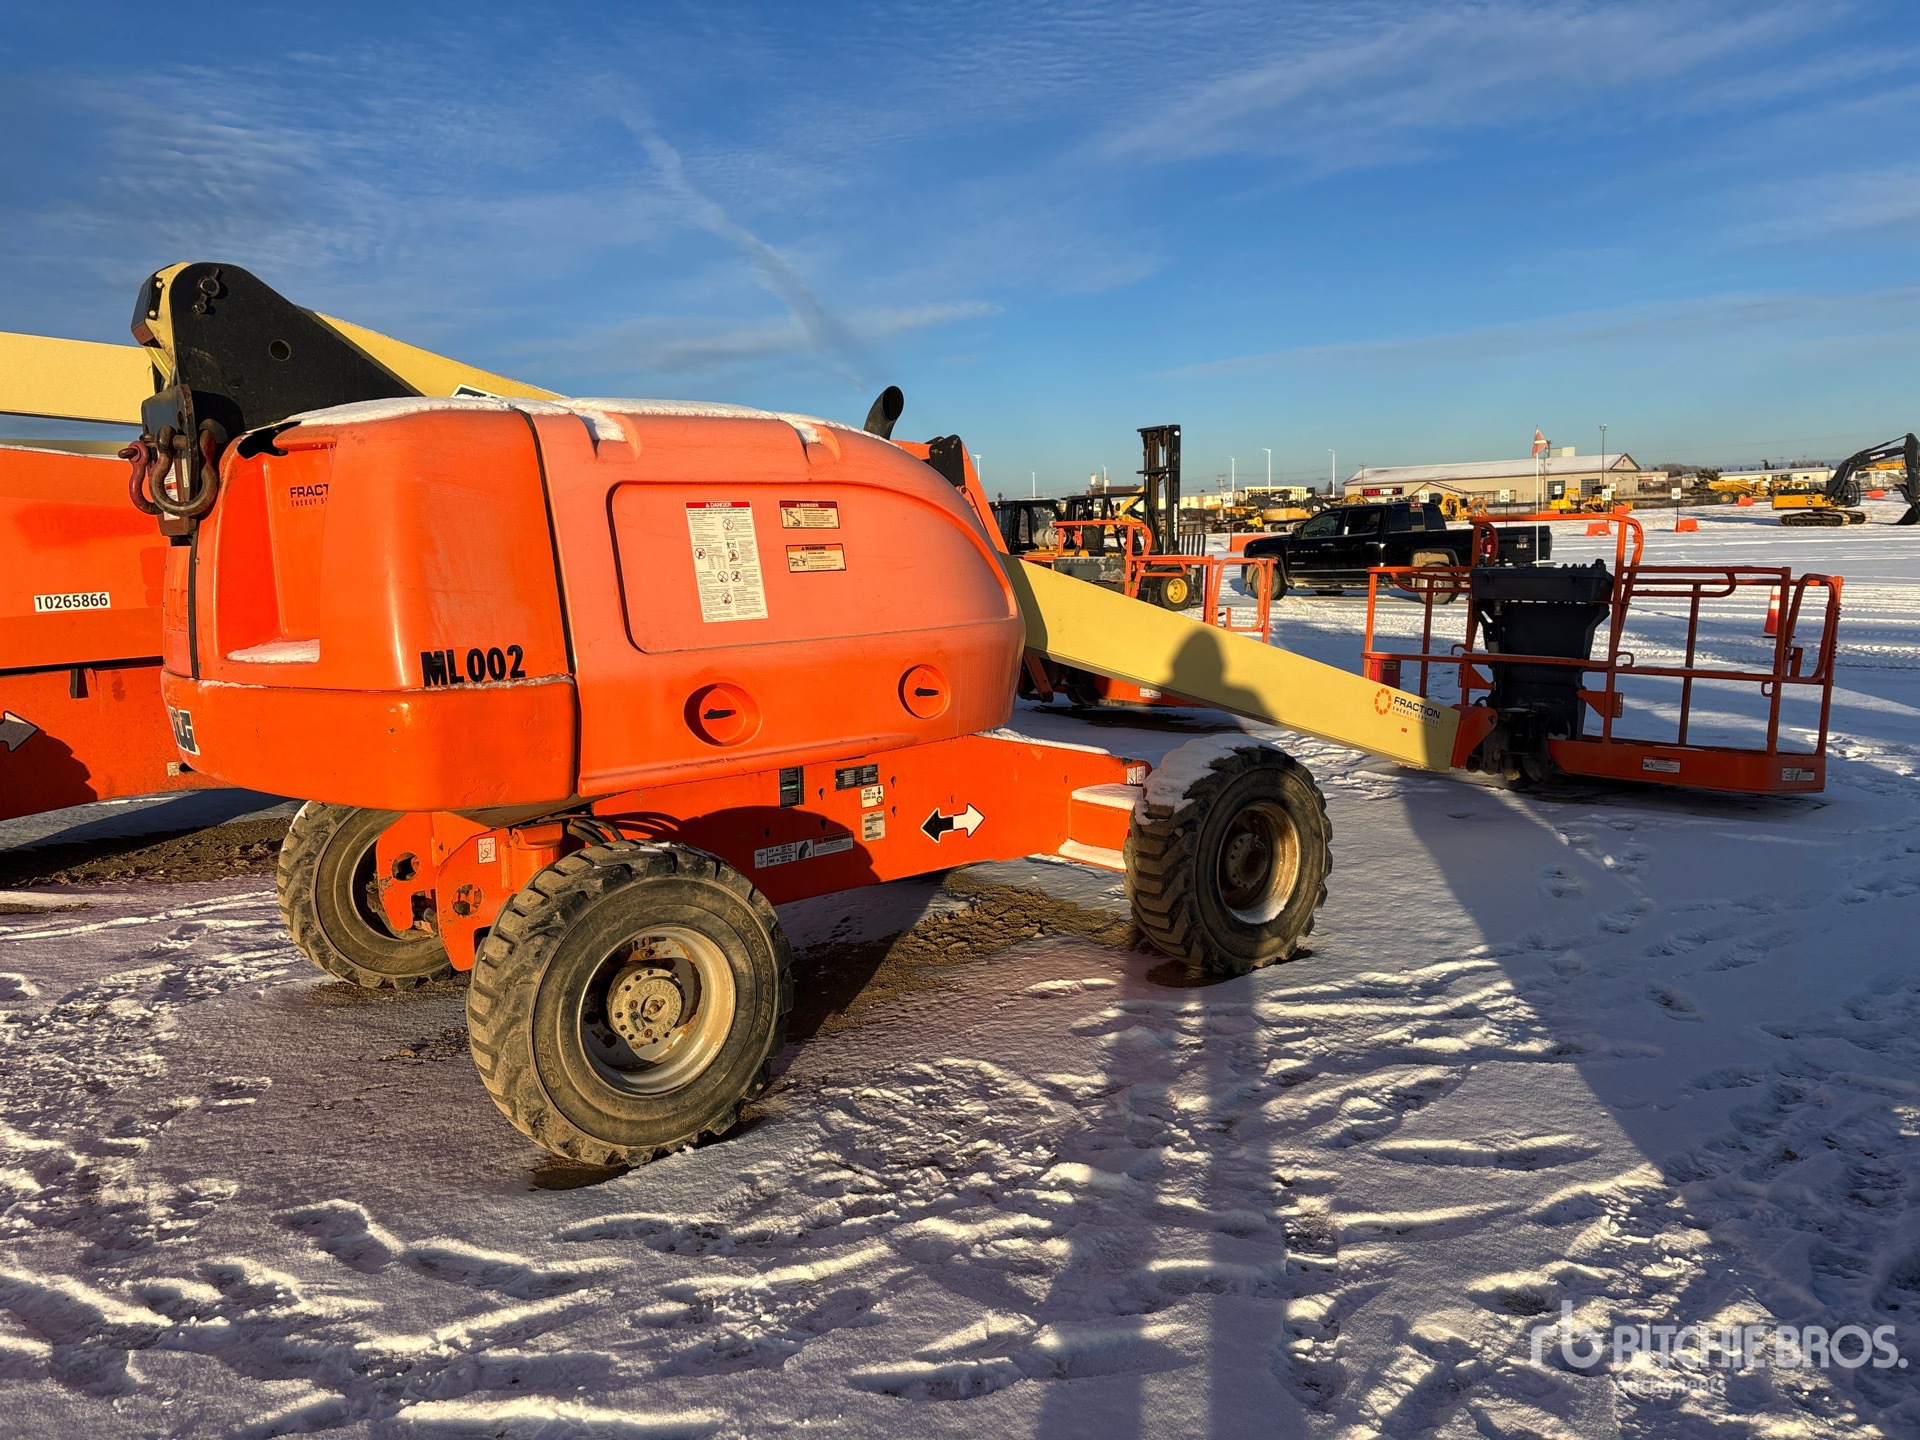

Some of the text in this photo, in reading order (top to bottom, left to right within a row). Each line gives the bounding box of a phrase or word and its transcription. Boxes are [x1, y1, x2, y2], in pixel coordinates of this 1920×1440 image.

[291, 498, 317, 507] ENERGY
[35, 592, 109, 610] 10265866
[1392, 705, 1413, 716] ENERGY
[1393, 696, 1441, 719] FRACTION
[728, 905, 773, 1037] OUTRIGGER
[537, 1037, 561, 1088] OTR
